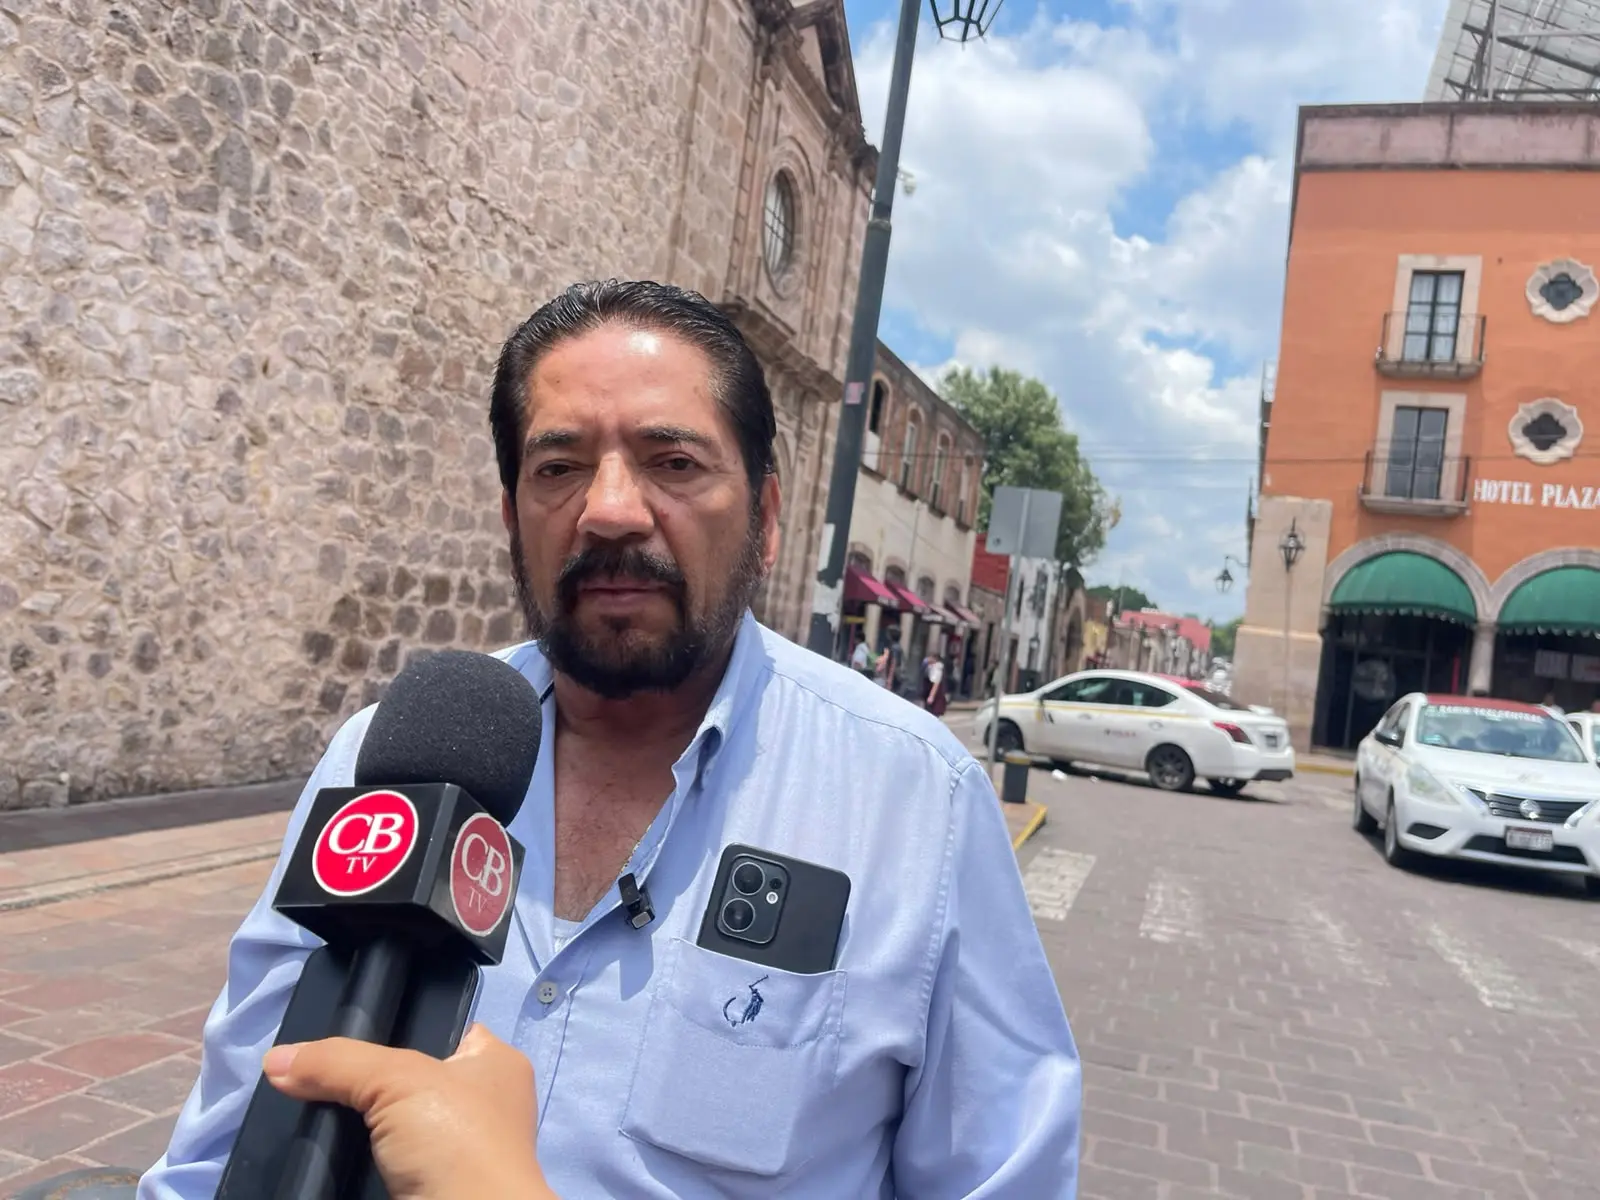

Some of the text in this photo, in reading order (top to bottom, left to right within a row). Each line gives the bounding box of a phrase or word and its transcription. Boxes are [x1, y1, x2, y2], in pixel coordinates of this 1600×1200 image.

[1473, 479, 1534, 505] HOTEL
[328, 813, 405, 855] CB
[346, 856, 378, 874] TV
[461, 833, 505, 897] CB
[468, 886, 488, 914] TV
